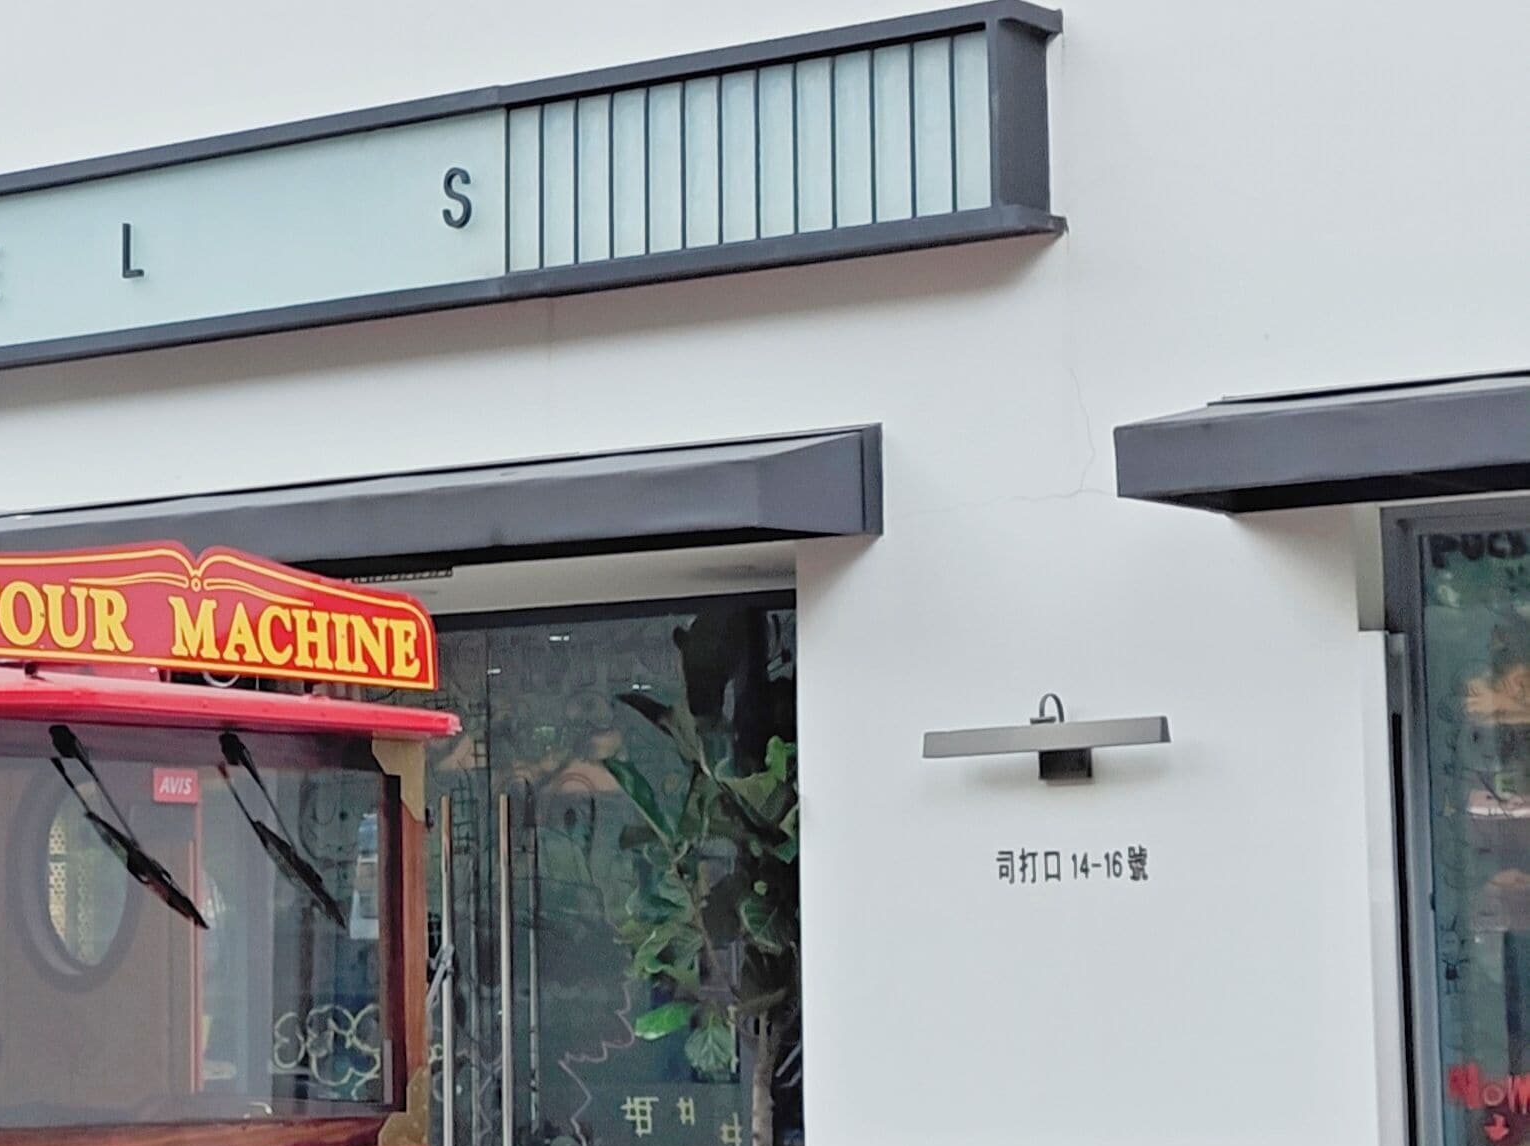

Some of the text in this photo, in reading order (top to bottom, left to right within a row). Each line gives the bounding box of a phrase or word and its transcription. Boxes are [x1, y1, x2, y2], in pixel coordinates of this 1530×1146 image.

[443, 167, 472, 229] S
[168, 594, 422, 679] MACHINE
[159, 776, 193, 796] AVIS
[996, 845, 1149, 884] 司打口 14-16 號
